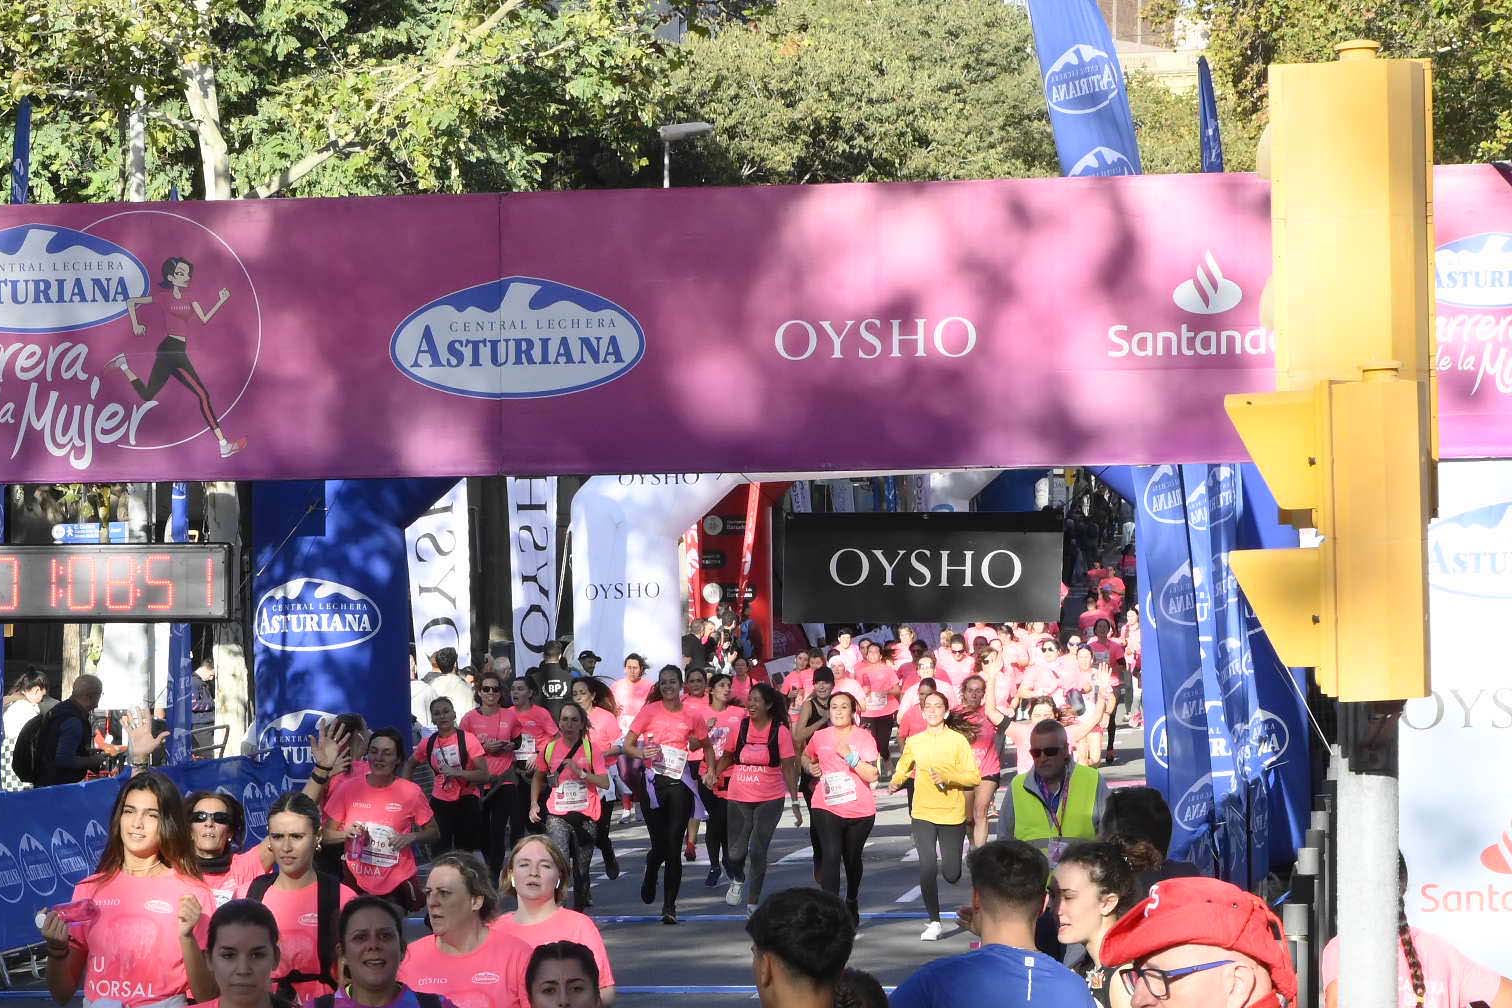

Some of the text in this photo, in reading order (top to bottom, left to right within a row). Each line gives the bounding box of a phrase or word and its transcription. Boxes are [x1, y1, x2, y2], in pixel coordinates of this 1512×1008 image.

[51, 260, 125, 273] LECHERA
[449, 316, 617, 332] CENTRAL LECHERA
[773, 316, 977, 361] OYSHO
[409, 322, 626, 370] ASTURIANA
[10, 375, 159, 470] Mujer
[829, 546, 1023, 590] OYSHO
[584, 581, 662, 601] OYSHO
[259, 607, 373, 635] ASTURIANA
